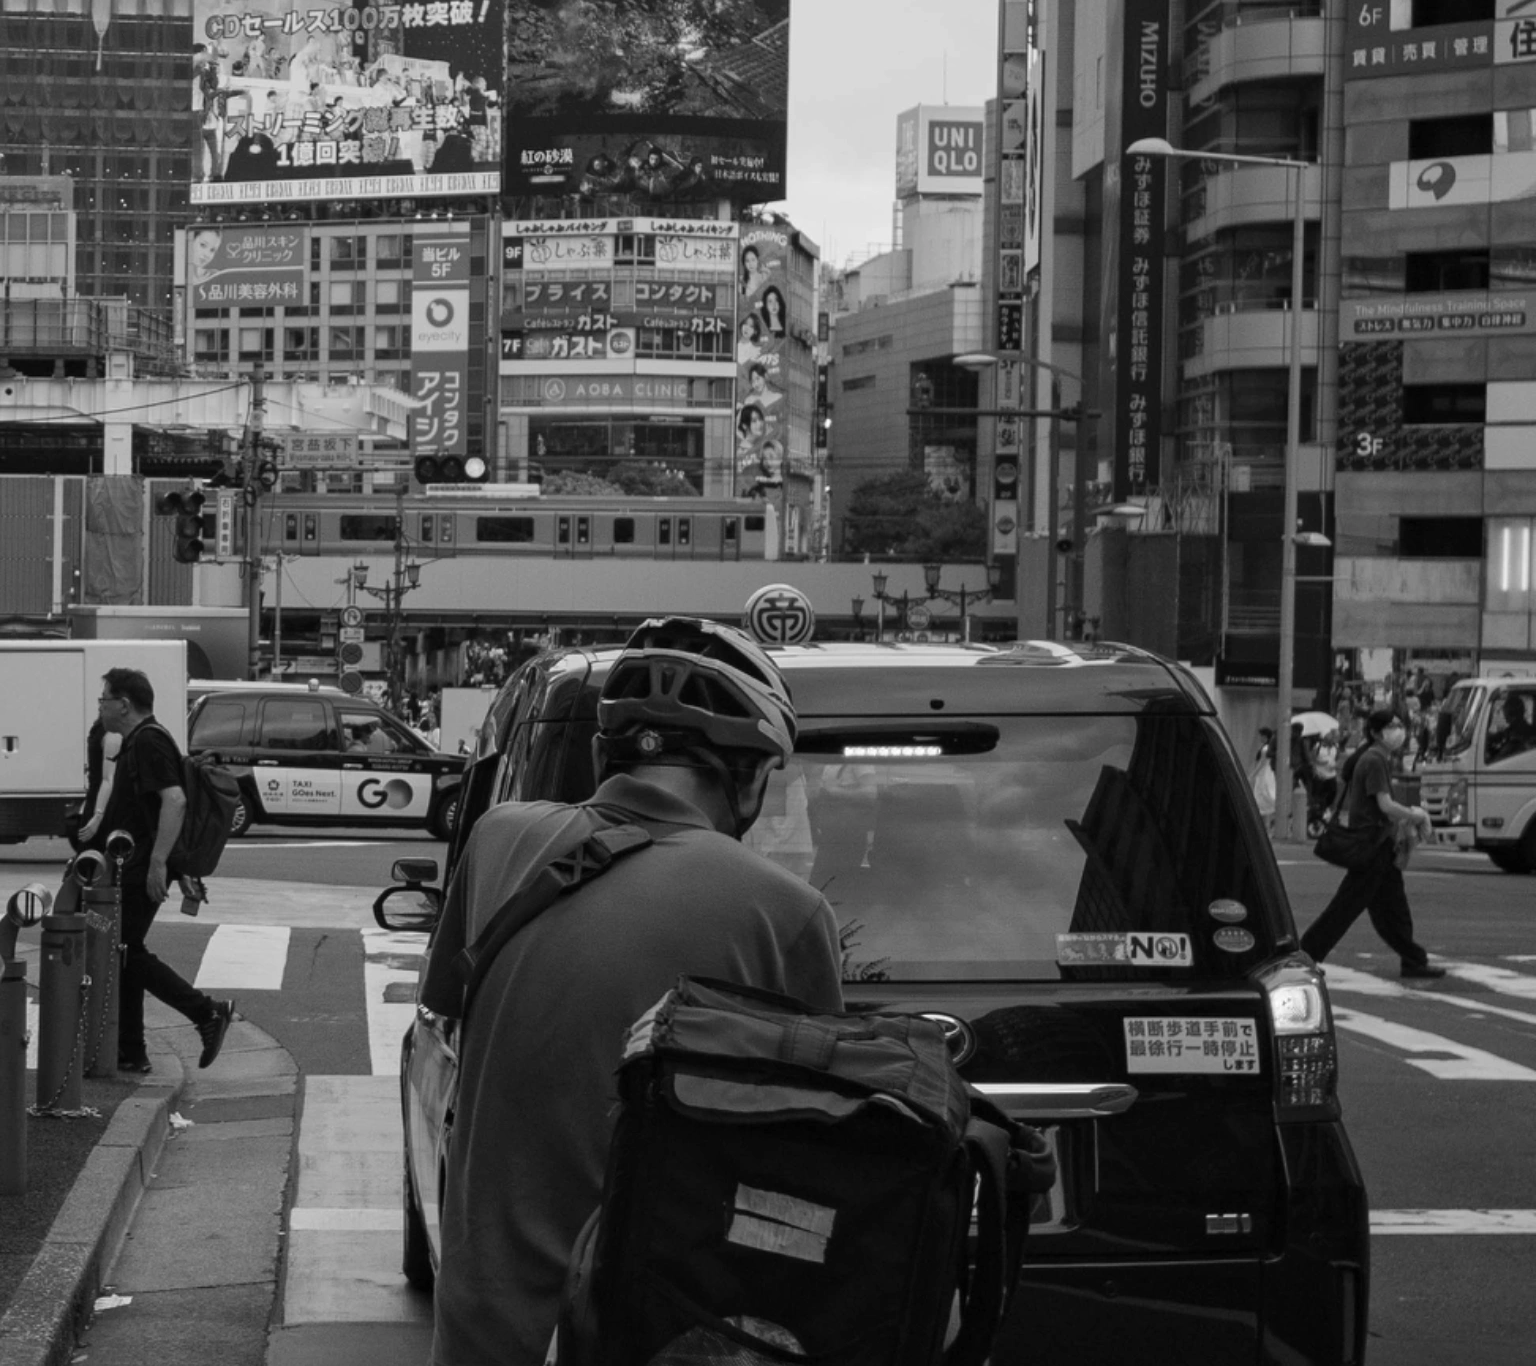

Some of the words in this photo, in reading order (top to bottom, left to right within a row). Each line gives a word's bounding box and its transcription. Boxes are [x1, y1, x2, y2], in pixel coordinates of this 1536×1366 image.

[1358, 3, 1383, 27] 6F
[1403, 41, 1436, 61] 売買
[1453, 36, 1488, 57] 管理
[1139, 21, 1159, 108] MIZUHO
[933, 126, 974, 148] UNI
[933, 150, 977, 174] QLO
[1133, 155, 1151, 245] みずほ証券
[242, 236, 299, 250] 品川スキン
[242, 249, 294, 263] クリニック
[422, 246, 460, 262] 当ビル
[505, 246, 522, 259] 9F
[431, 262, 452, 277] 5F
[208, 282, 298, 300] 品川美容外科
[525, 284, 609, 301] プライス
[635, 284, 713, 302] コンタクト
[577, 314, 618, 331] ガスト
[691, 316, 727, 333] ガスト
[1131, 257, 1150, 381] みずほ信託銀行
[418, 330, 462, 344] eyecity
[503, 339, 521, 353] 7F
[551, 336, 603, 357] ガスト
[575, 382, 624, 396] AOBA
[635, 382, 688, 397] CLINIC
[443, 371, 461, 455] コンタク
[1128, 393, 1147, 482] みずほ銀行
[1356, 432, 1384, 457] 3F
[292, 780, 312, 788] TAXI
[1128, 1019, 1253, 1037] 横断歩道手前で
[1129, 1039, 1256, 1057] 最徐行一時停止
[1223, 1059, 1256, 1071] します
